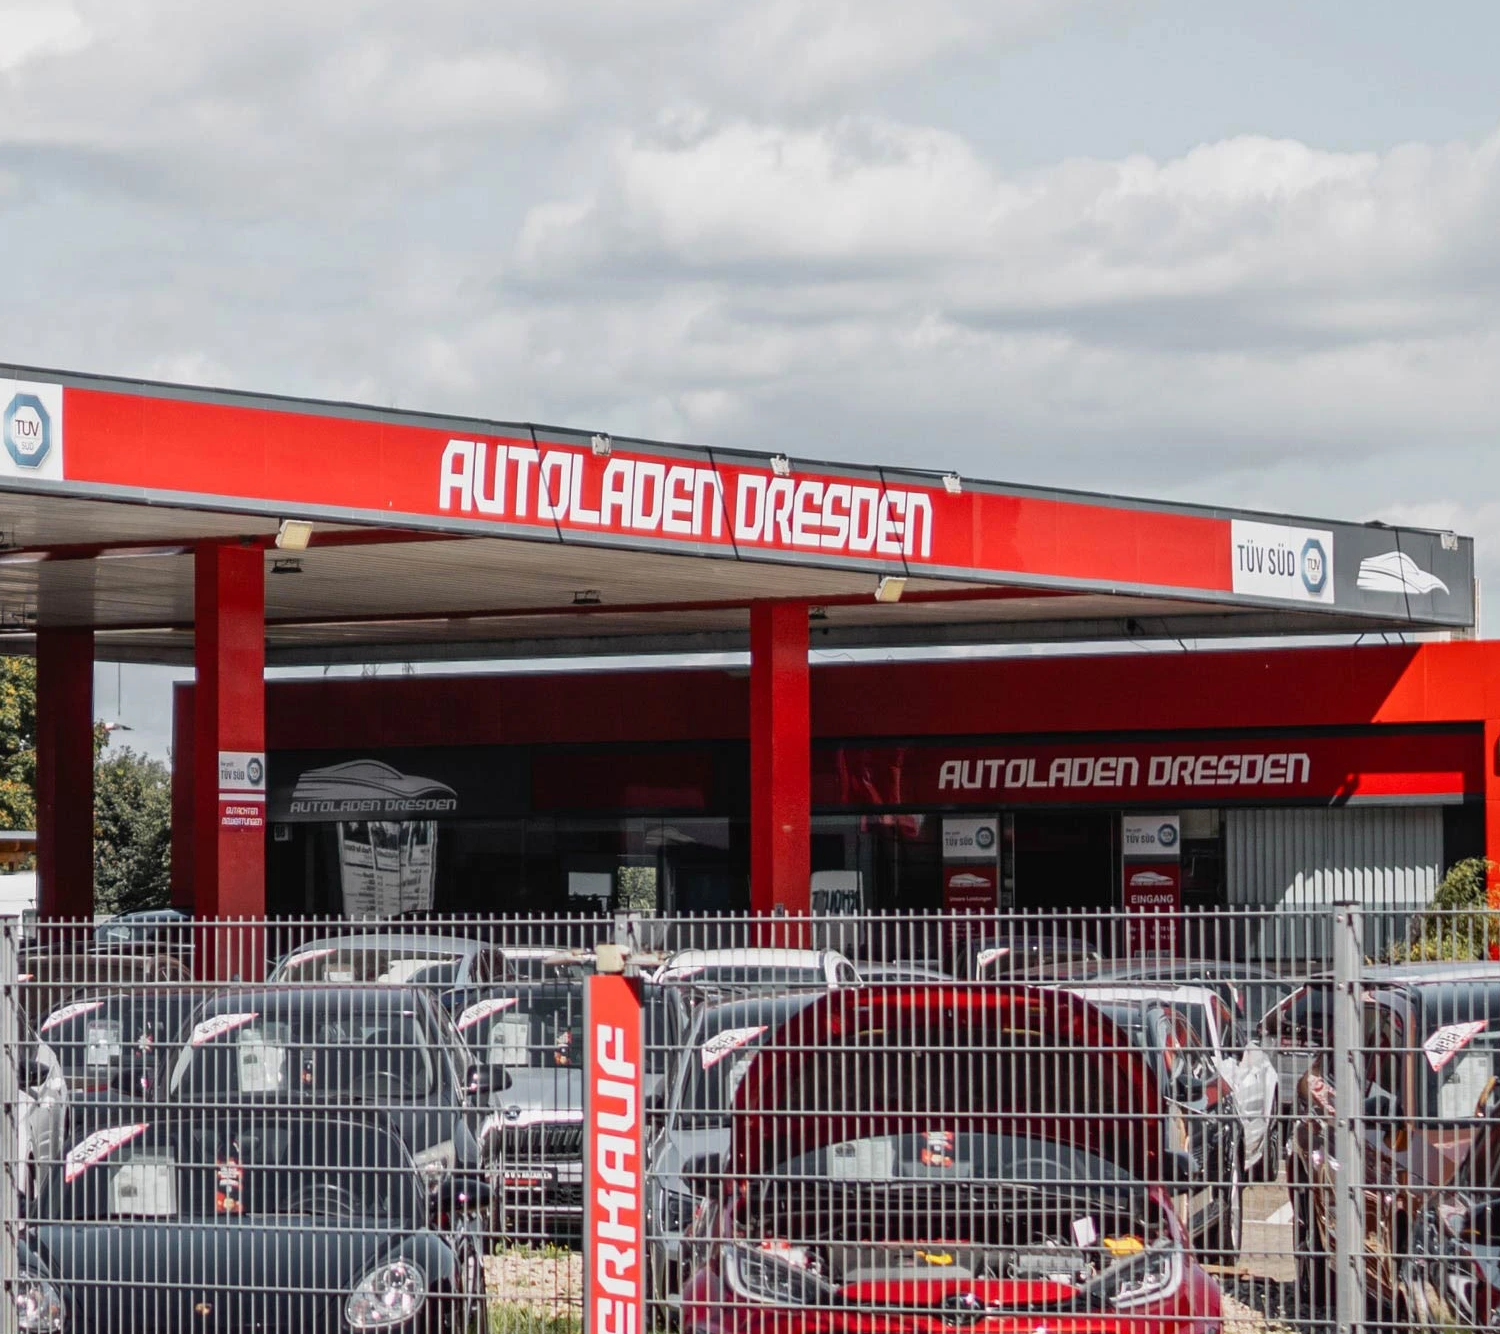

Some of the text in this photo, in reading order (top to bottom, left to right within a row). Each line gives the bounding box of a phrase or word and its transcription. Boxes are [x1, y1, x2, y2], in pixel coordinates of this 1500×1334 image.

[15, 418, 40, 437] TÜV
[438, 438, 933, 559] AUTOLADEN DRESDEN
[1237, 539, 1296, 577] TÜV SÜD
[221, 769, 232, 780] TÜV
[938, 752, 1310, 790] AUTOLADEN DRESDEN
[290, 798, 457, 813] AUTOLADEN DRESDEN
[945, 836, 973, 847] TÜV SÜD
[1126, 832, 1156, 844] TÜV SÜD
[1130, 894, 1174, 904] EINGANG
